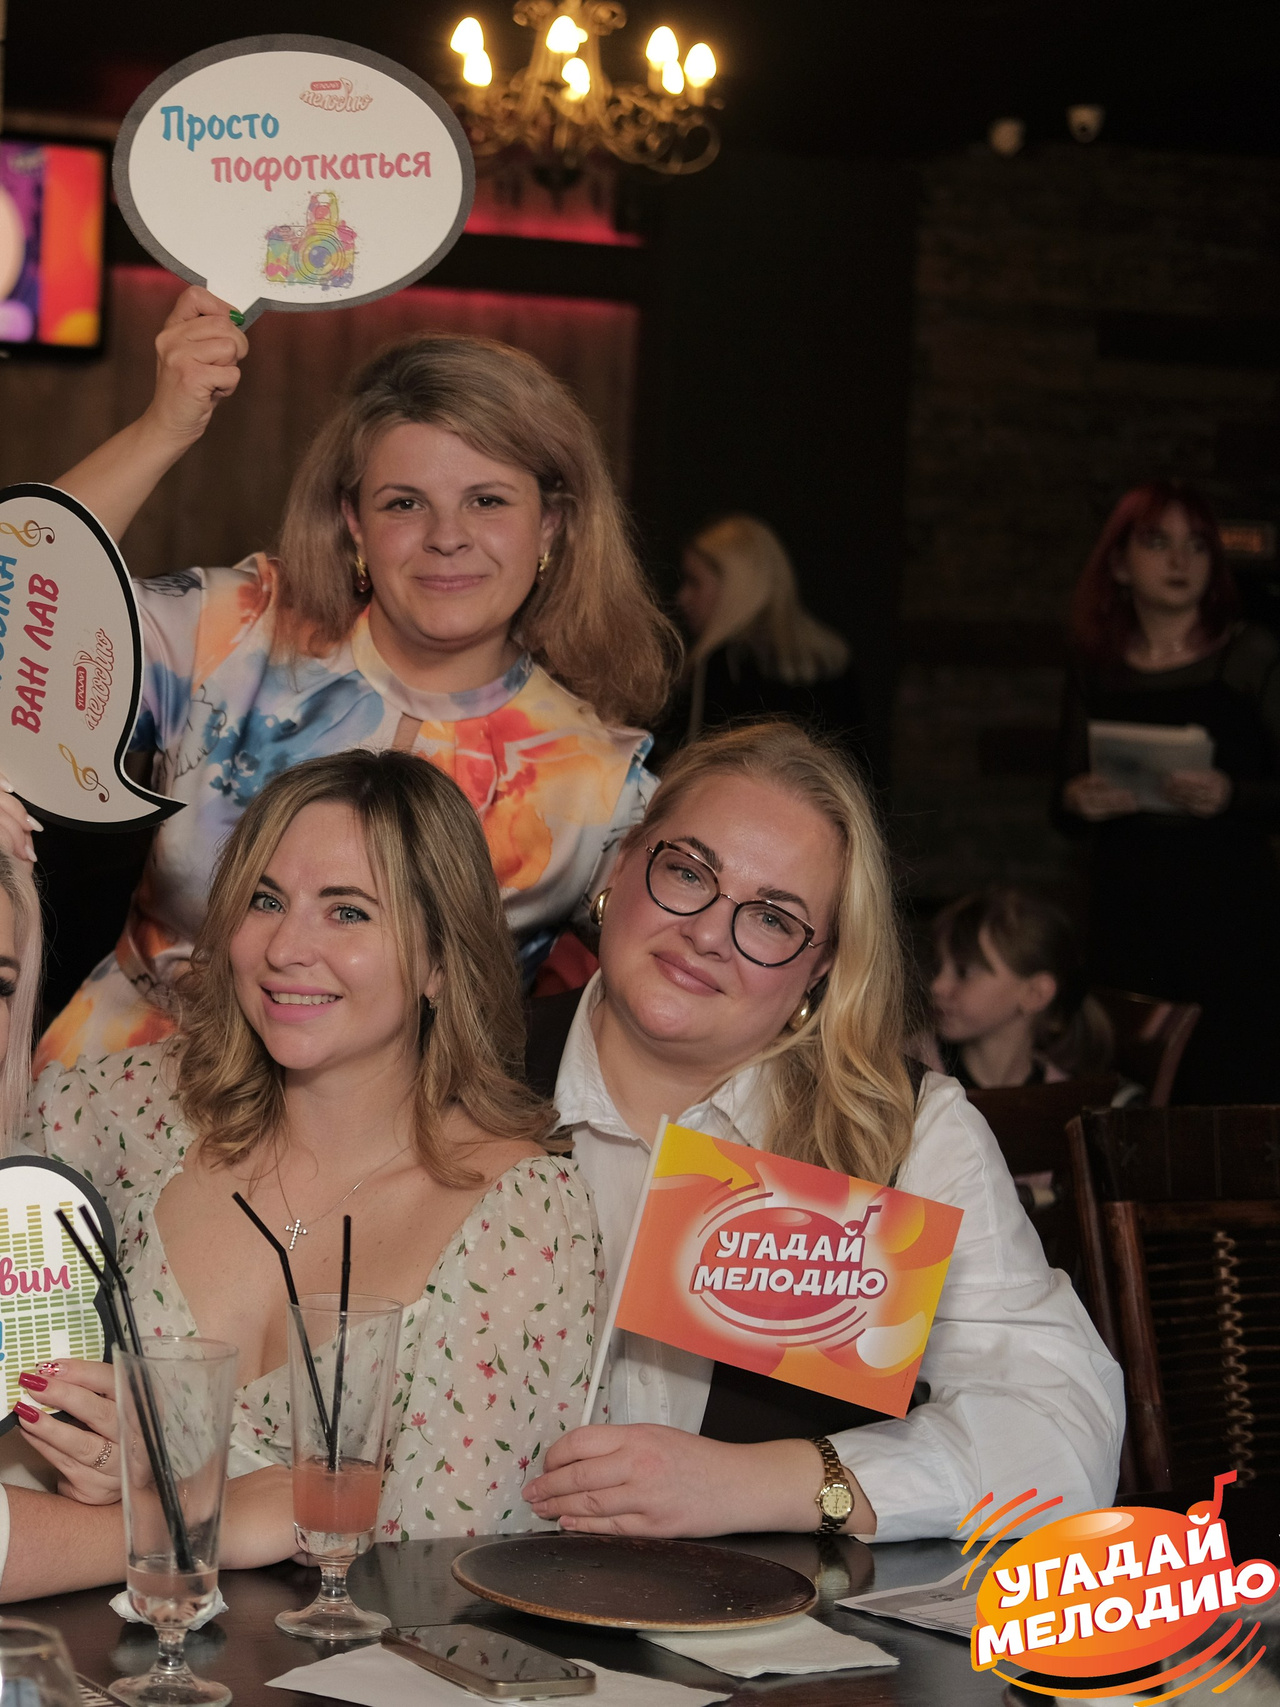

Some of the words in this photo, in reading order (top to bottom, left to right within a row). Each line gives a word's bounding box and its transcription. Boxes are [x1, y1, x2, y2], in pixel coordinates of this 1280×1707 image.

[160, 105, 280, 152] Просто
[210, 151, 432, 192] пофоткаться
[23, 573, 60, 651] ЛАВ
[11, 656, 50, 734] ВАН
[715, 1227, 863, 1263] УГАДАЙ
[693, 1266, 886, 1297] МЕЛОДИЮ
